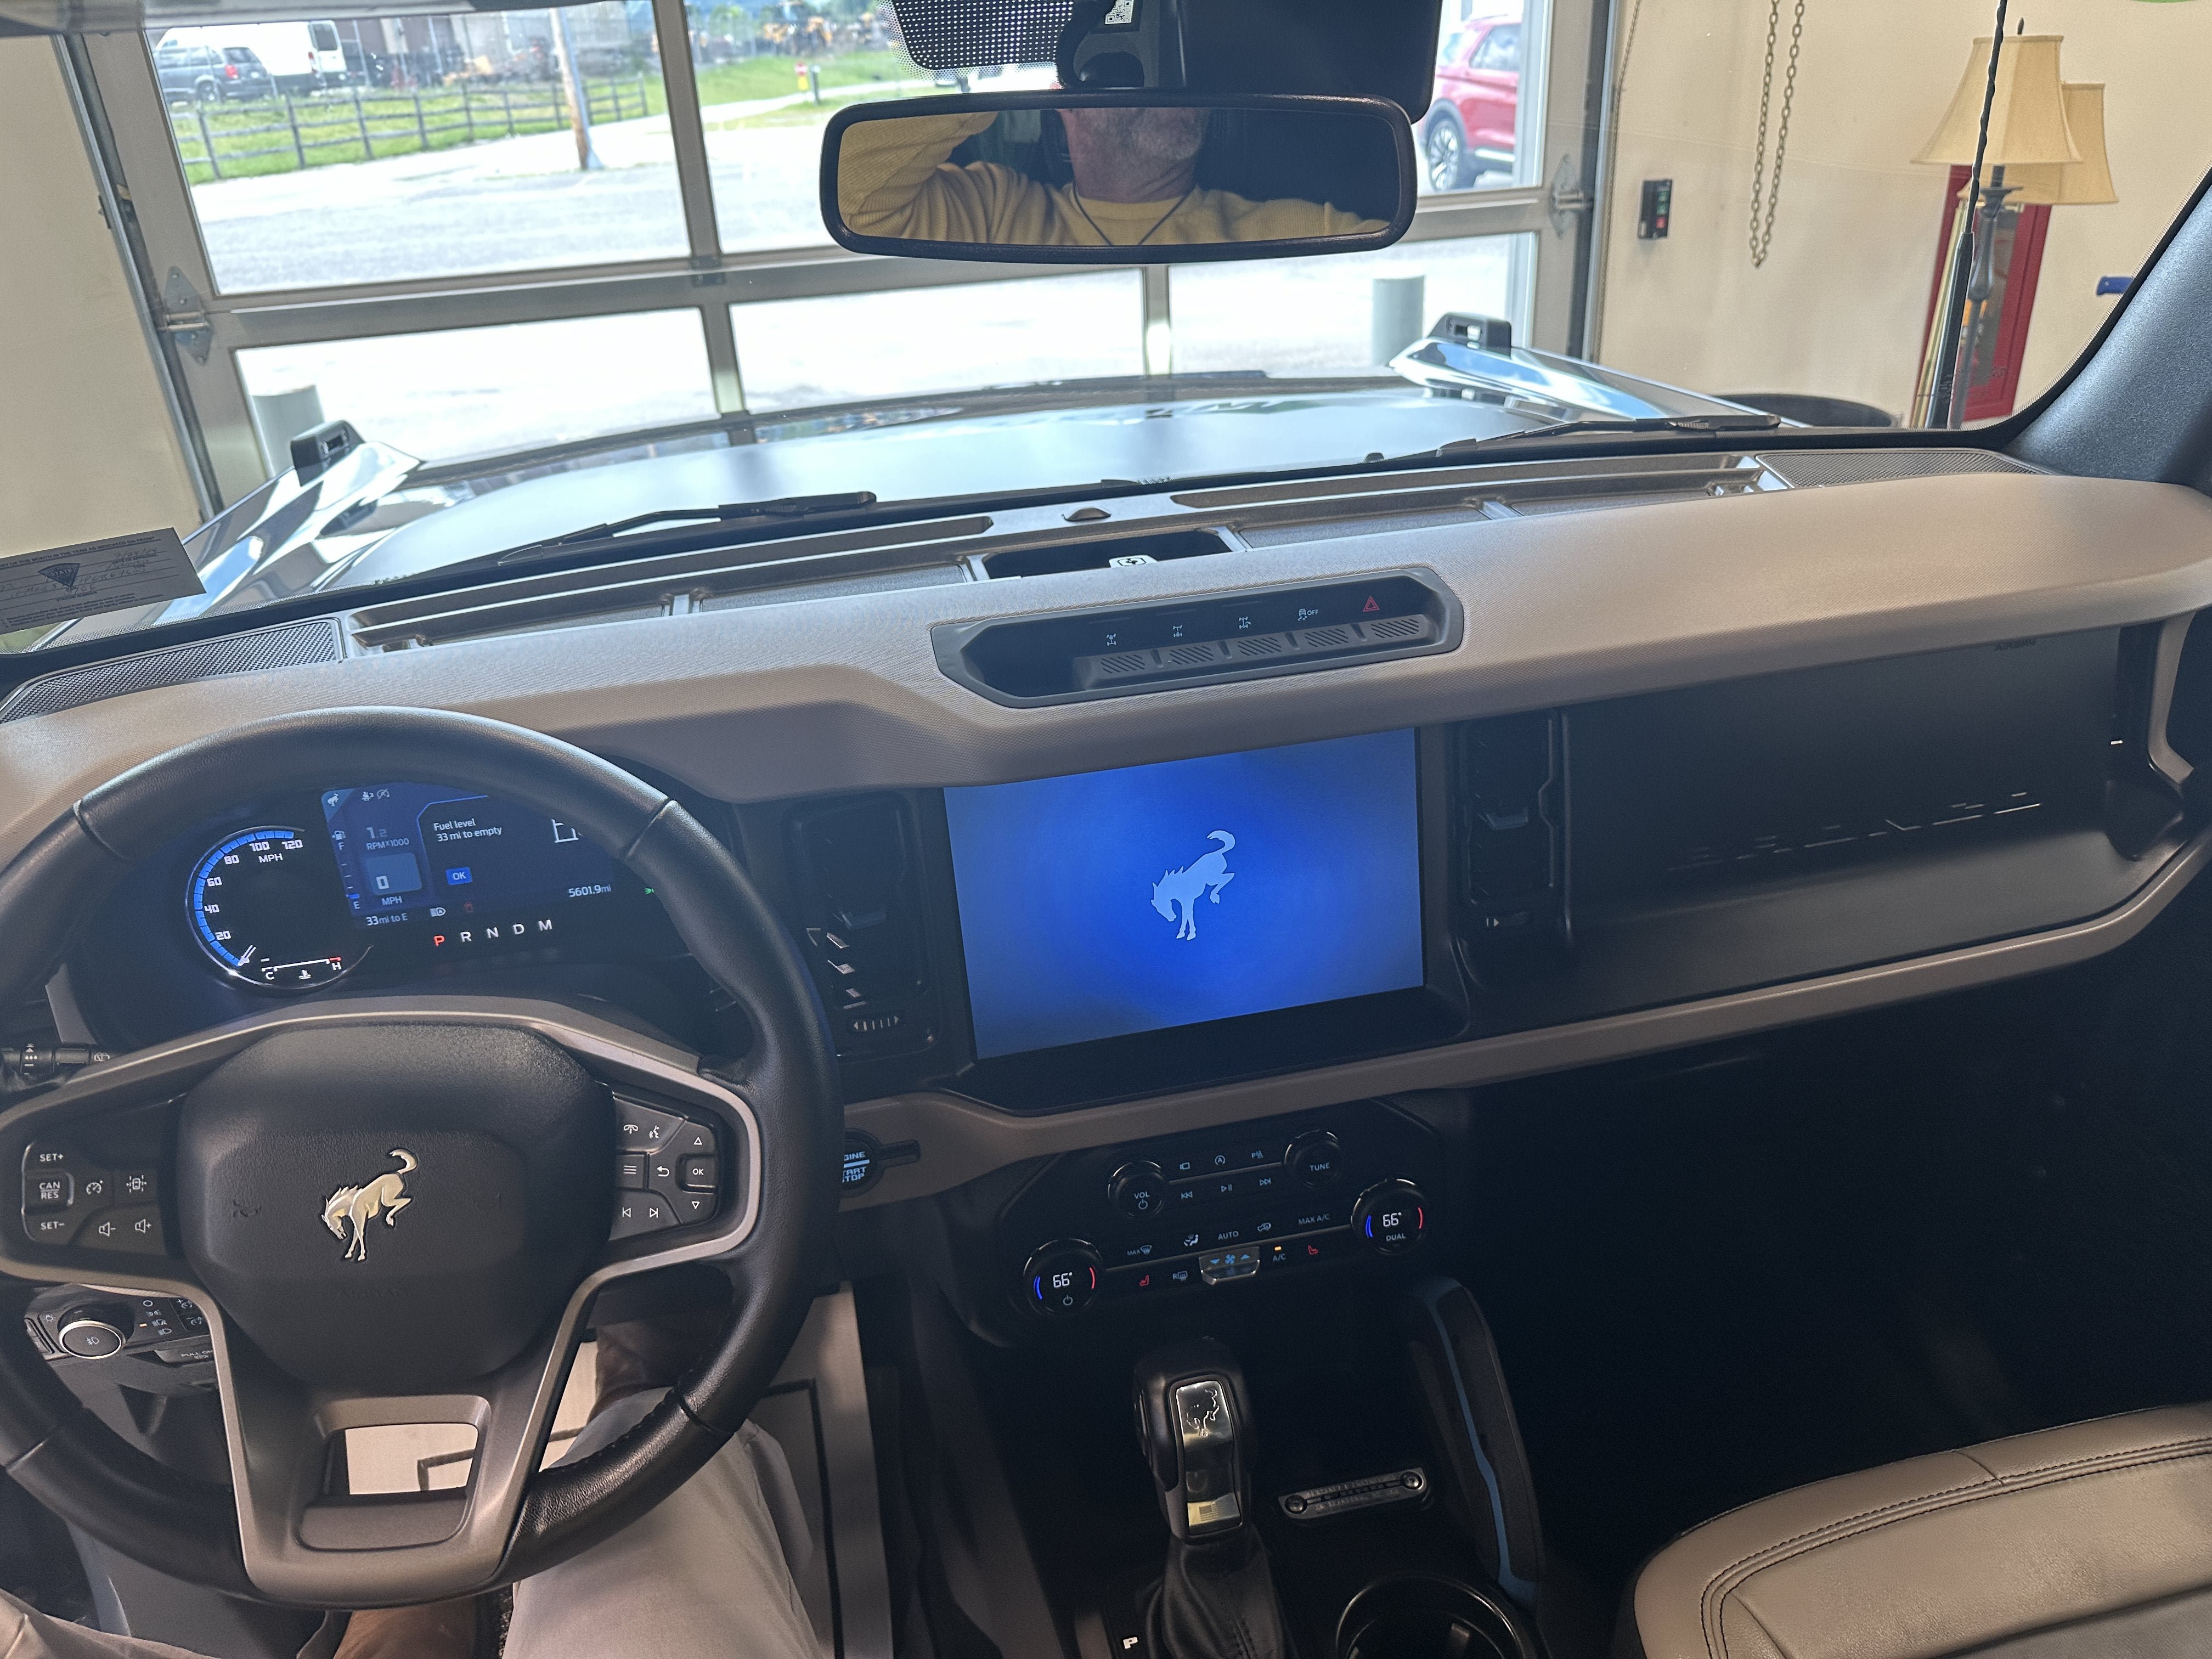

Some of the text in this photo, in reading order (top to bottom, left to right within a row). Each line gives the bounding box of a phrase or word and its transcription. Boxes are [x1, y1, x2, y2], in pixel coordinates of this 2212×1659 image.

[97, 541, 127, 549] INDICATED
[433, 818, 476, 832] Fuel level
[437, 826, 502, 842] 33 mi to empty
[249, 841, 270, 852] 100
[282, 839, 303, 851] 120
[338, 842, 345, 850] F
[224, 855, 240, 865] 80
[258, 853, 283, 864] MPH
[452, 871, 466, 881] OK
[206, 877, 222, 887] 60
[376, 875, 390, 890] 0
[353, 901, 360, 910] E
[381, 895, 403, 906] MPH
[204, 904, 220, 913] 40
[391, 915, 400, 923] to
[401, 912, 408, 921] E
[216, 930, 232, 941] 20
[433, 919, 553, 947] P R N D M
[332, 962, 342, 971] H
[266, 971, 275, 981] C
[39, 1153, 64, 1163] SET+
[844, 1151, 866, 1161] GINE
[1309, 1161, 1330, 1172] TUNE
[842, 1173, 865, 1183] TOP
[39, 1181, 61, 1190] CAN
[41, 1190, 59, 1200] RES
[1133, 1191, 1150, 1200] VOL
[1298, 1213, 1330, 1226] MAX A/C
[1217, 1230, 1239, 1241] AUTO
[1385, 1233, 1406, 1243] DUAL
[1272, 1252, 1286, 1262] A/C
[1122, 1637, 1138, 1649] P
